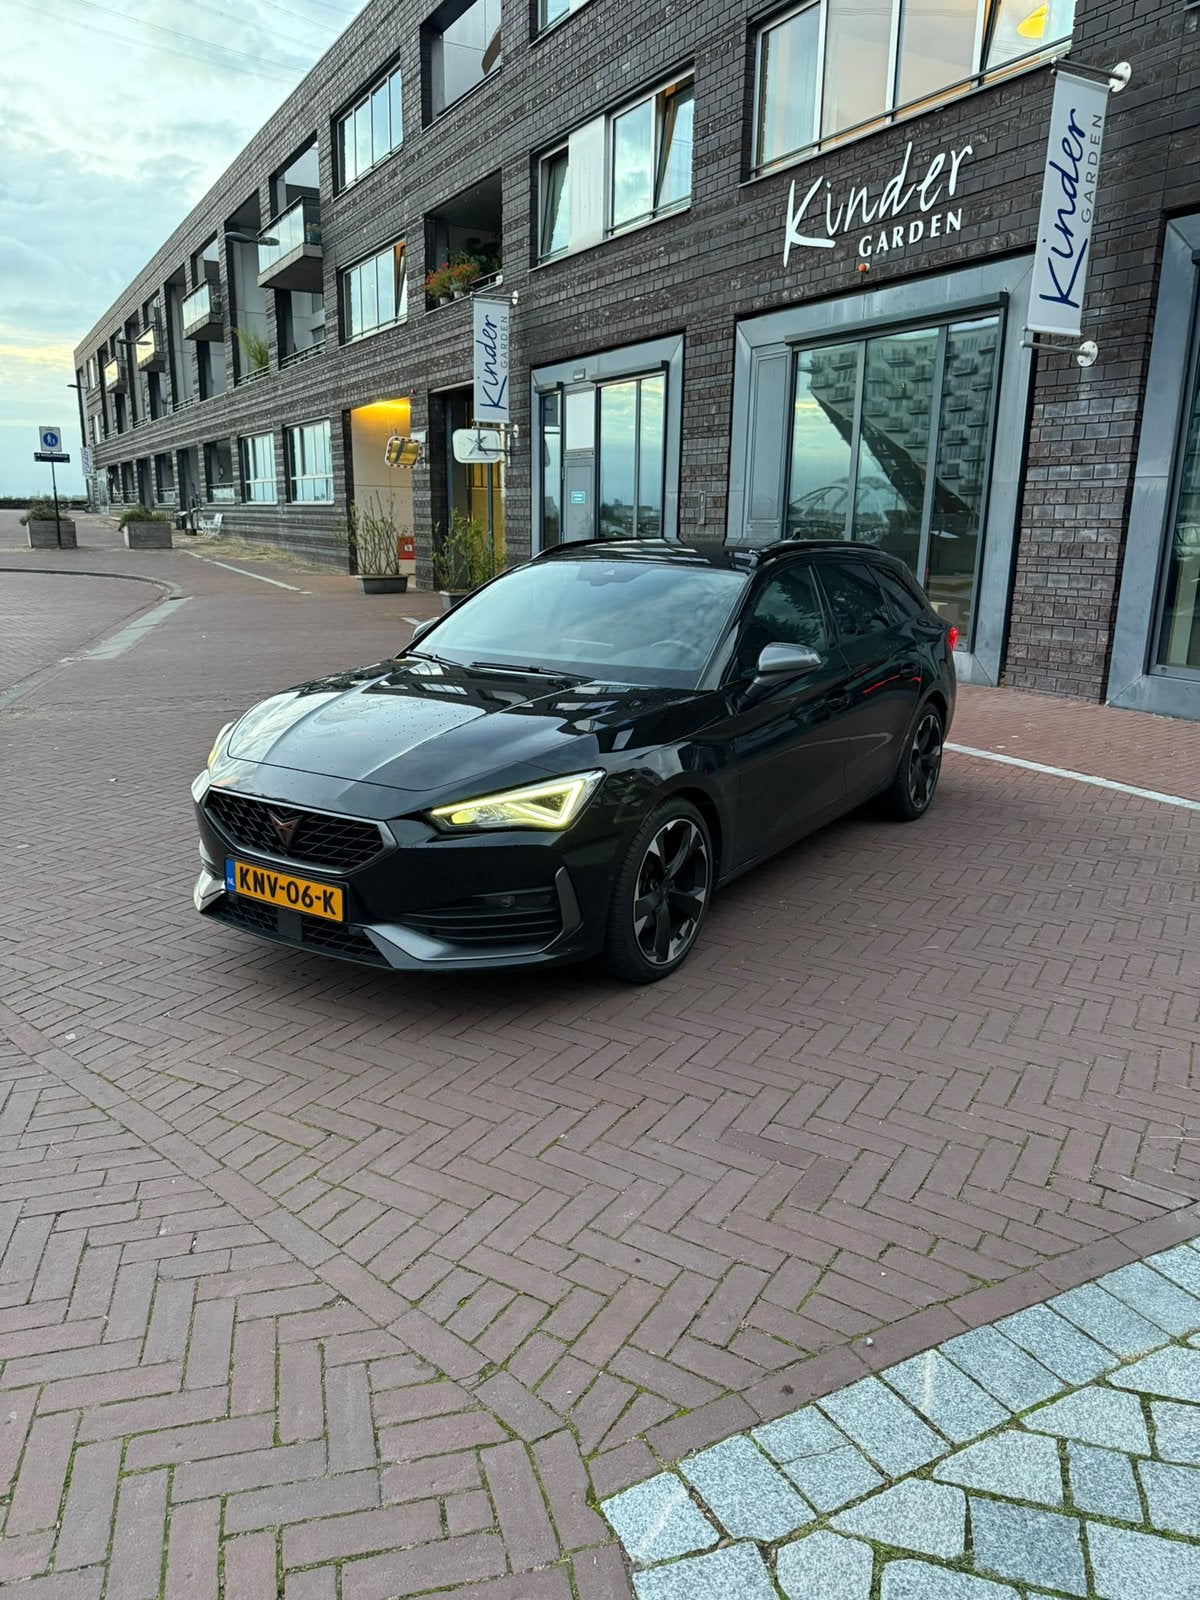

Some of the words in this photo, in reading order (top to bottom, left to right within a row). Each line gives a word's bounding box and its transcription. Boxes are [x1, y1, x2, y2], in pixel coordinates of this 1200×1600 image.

[783, 141, 973, 268] Kinder
[1039, 108, 1088, 309] Kinder
[1081, 114, 1103, 224] GARDEN
[858, 208, 963, 258] GARDEN
[475, 314, 507, 410] Kinder
[500, 316, 508, 369] GARDEN
[239, 866, 336, 915] KNV-06-K
